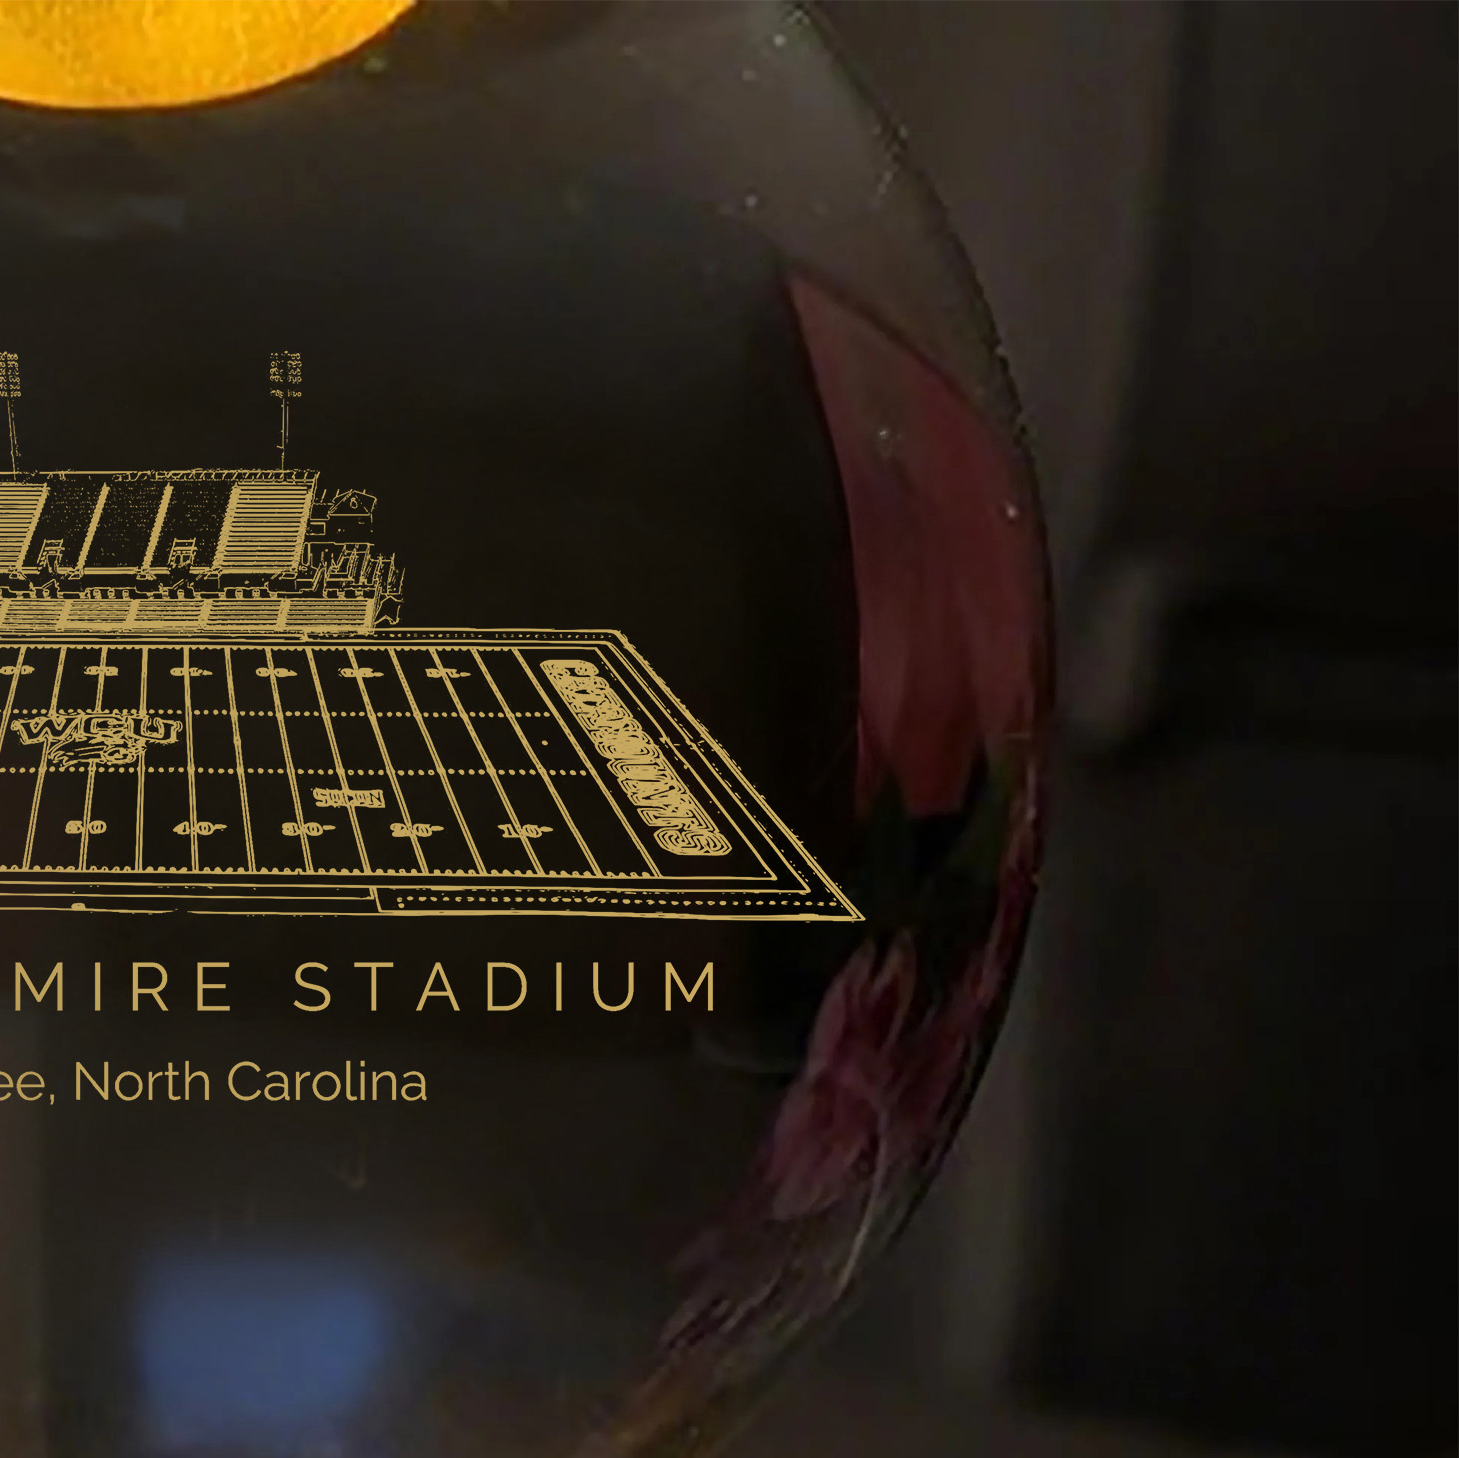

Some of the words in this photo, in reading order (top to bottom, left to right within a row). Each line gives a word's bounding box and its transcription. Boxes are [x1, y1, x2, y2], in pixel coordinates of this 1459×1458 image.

[10, 712, 183, 746] WCU
[293, 961, 714, 1012] STADIUM
[75, 1060, 210, 1101] North
[227, 1060, 427, 1101] Carolina
